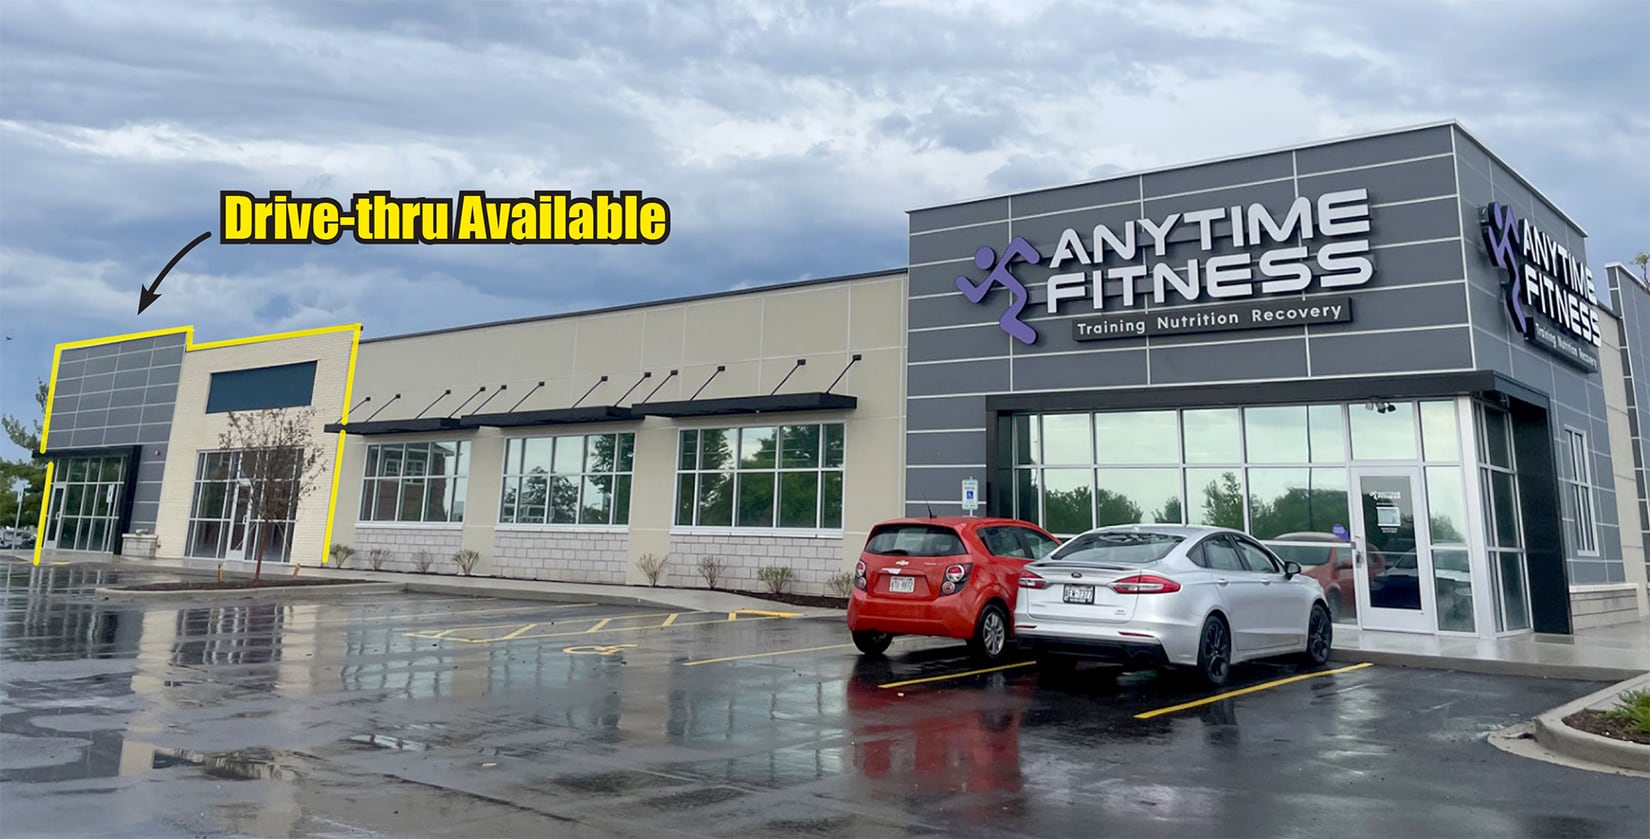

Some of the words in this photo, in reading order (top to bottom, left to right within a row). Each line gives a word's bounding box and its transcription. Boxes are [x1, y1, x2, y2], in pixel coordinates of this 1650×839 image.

[1049, 187, 1371, 269] ANYTIME
[1523, 217, 1598, 306] ANYTIME
[1046, 239, 1374, 314] FITNESS
[1524, 263, 1602, 348] FITNESS
[1077, 319, 1146, 335] Training
[1156, 311, 1240, 329] Nutrition
[1251, 305, 1342, 323] Recovery
